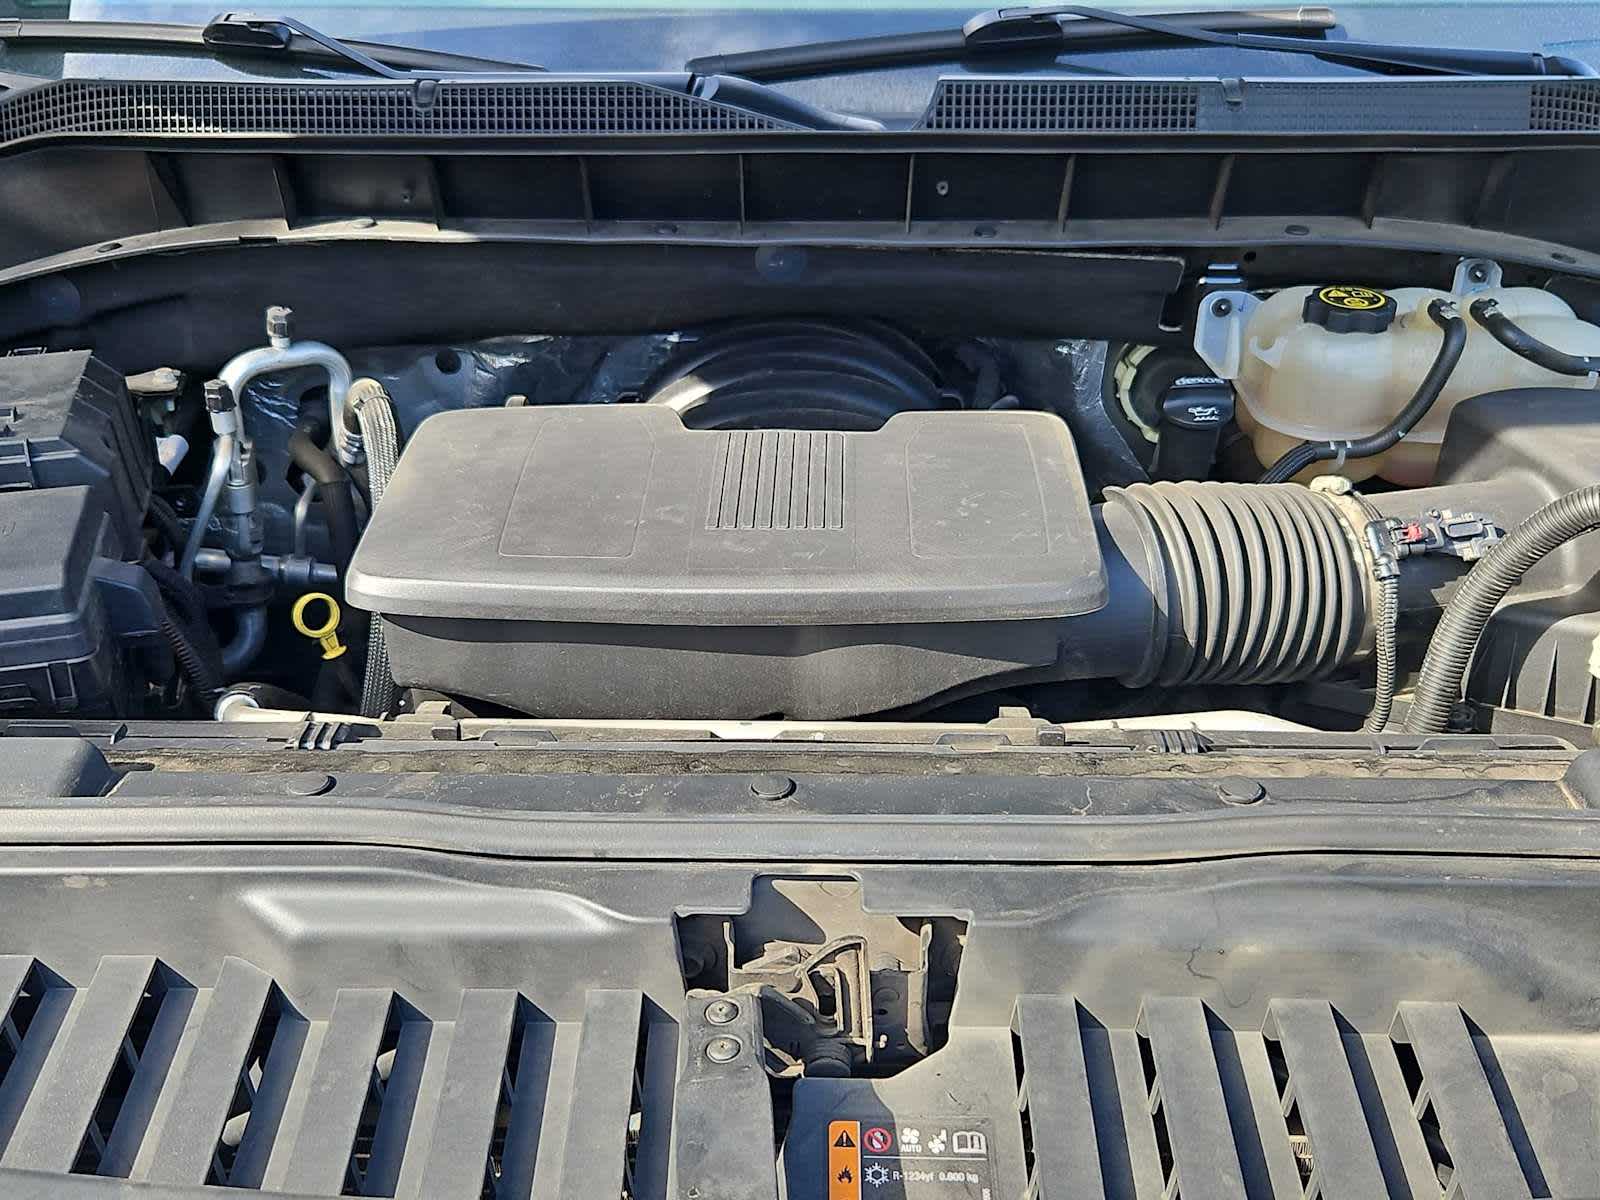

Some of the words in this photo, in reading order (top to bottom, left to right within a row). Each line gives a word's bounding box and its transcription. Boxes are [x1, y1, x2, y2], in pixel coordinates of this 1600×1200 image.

[900, 1144, 922, 1153] AUTO
[892, 1171, 934, 1183] R-1234yf
[966, 1171, 979, 1184] kg
